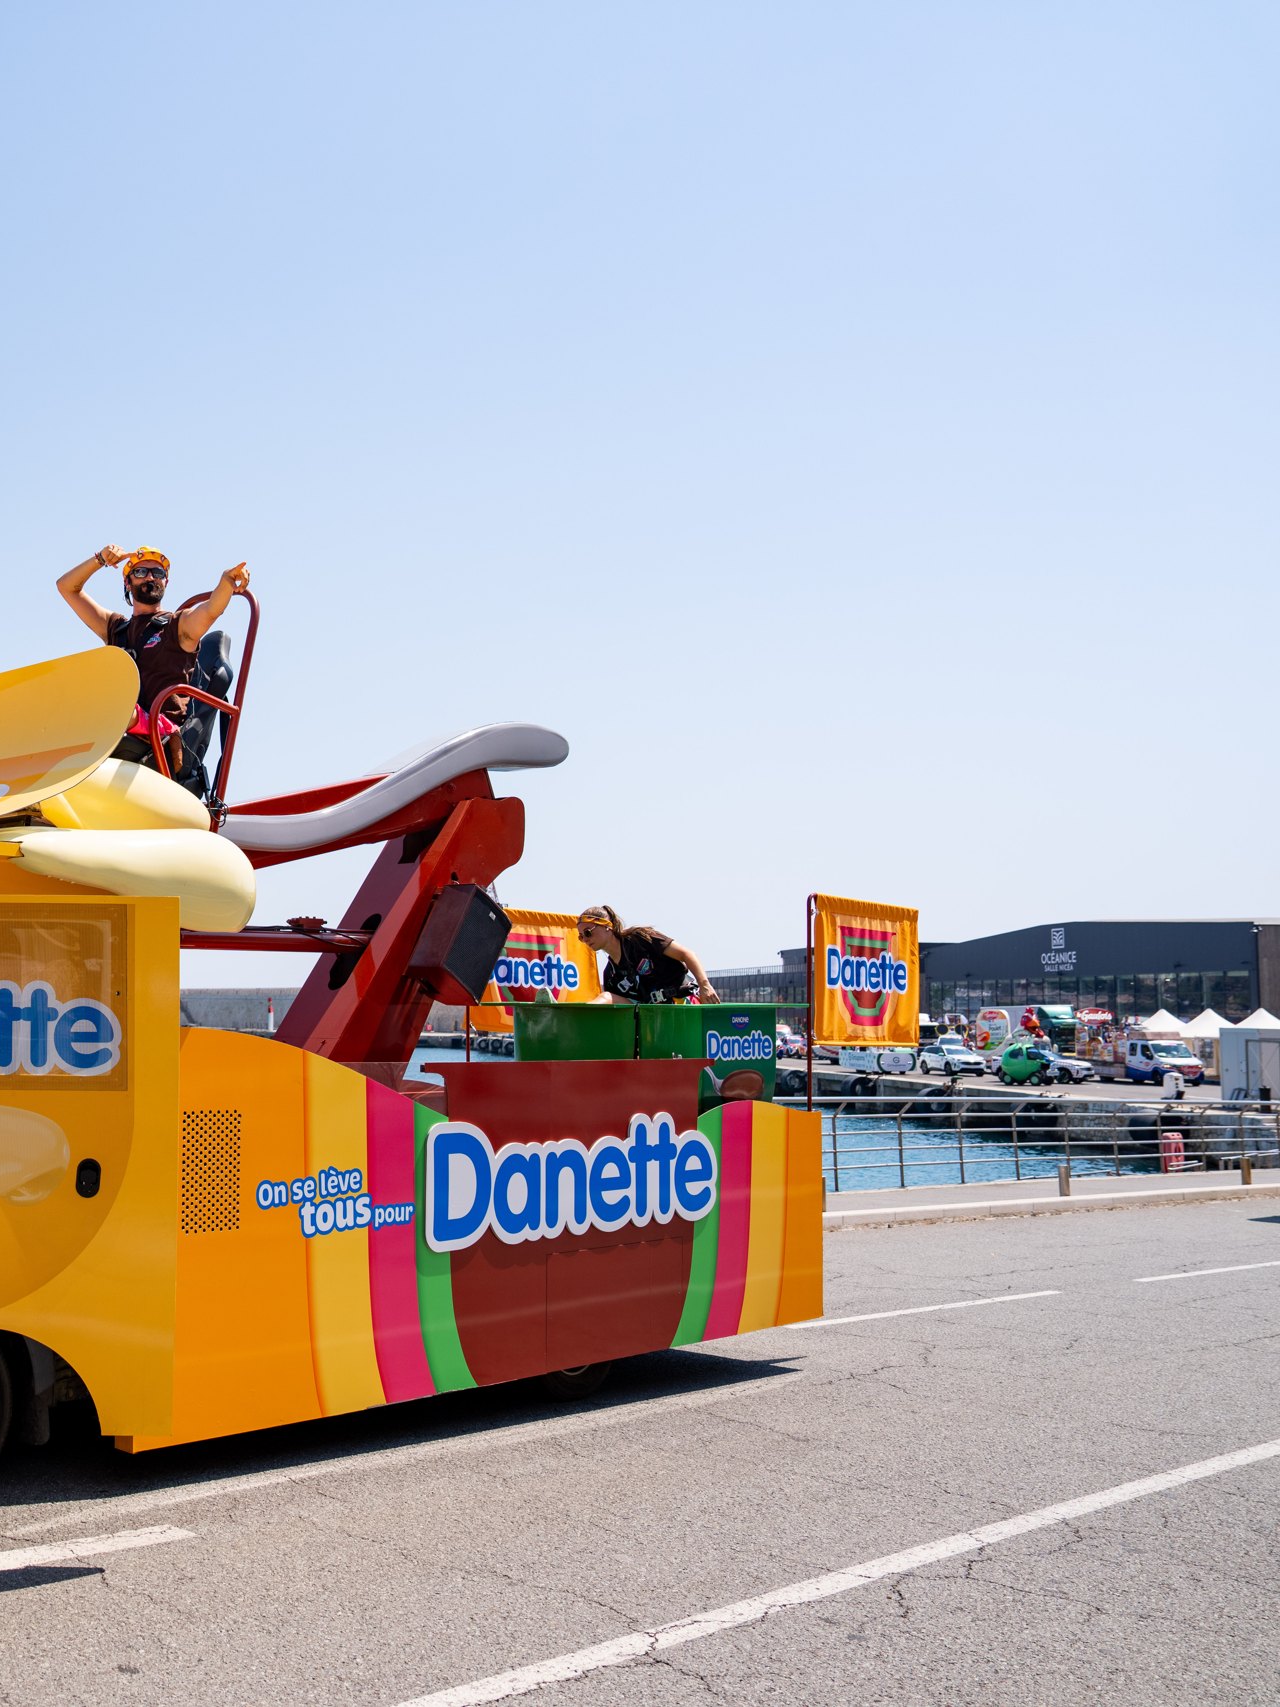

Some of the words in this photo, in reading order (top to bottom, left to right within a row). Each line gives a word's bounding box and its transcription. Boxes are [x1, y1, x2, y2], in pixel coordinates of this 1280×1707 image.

[489, 955, 578, 988] anette
[826, 946, 907, 992] Danette
[1041, 950, 1077, 964] OCÉANICE
[707, 1031, 772, 1060] Danette
[258, 1183, 287, 1206] On
[292, 1179, 315, 1201] se
[320, 1170, 361, 1196] lève
[430, 1119, 714, 1244] Danette
[301, 1196, 371, 1235] tous
[374, 1205, 414, 1228] pour
